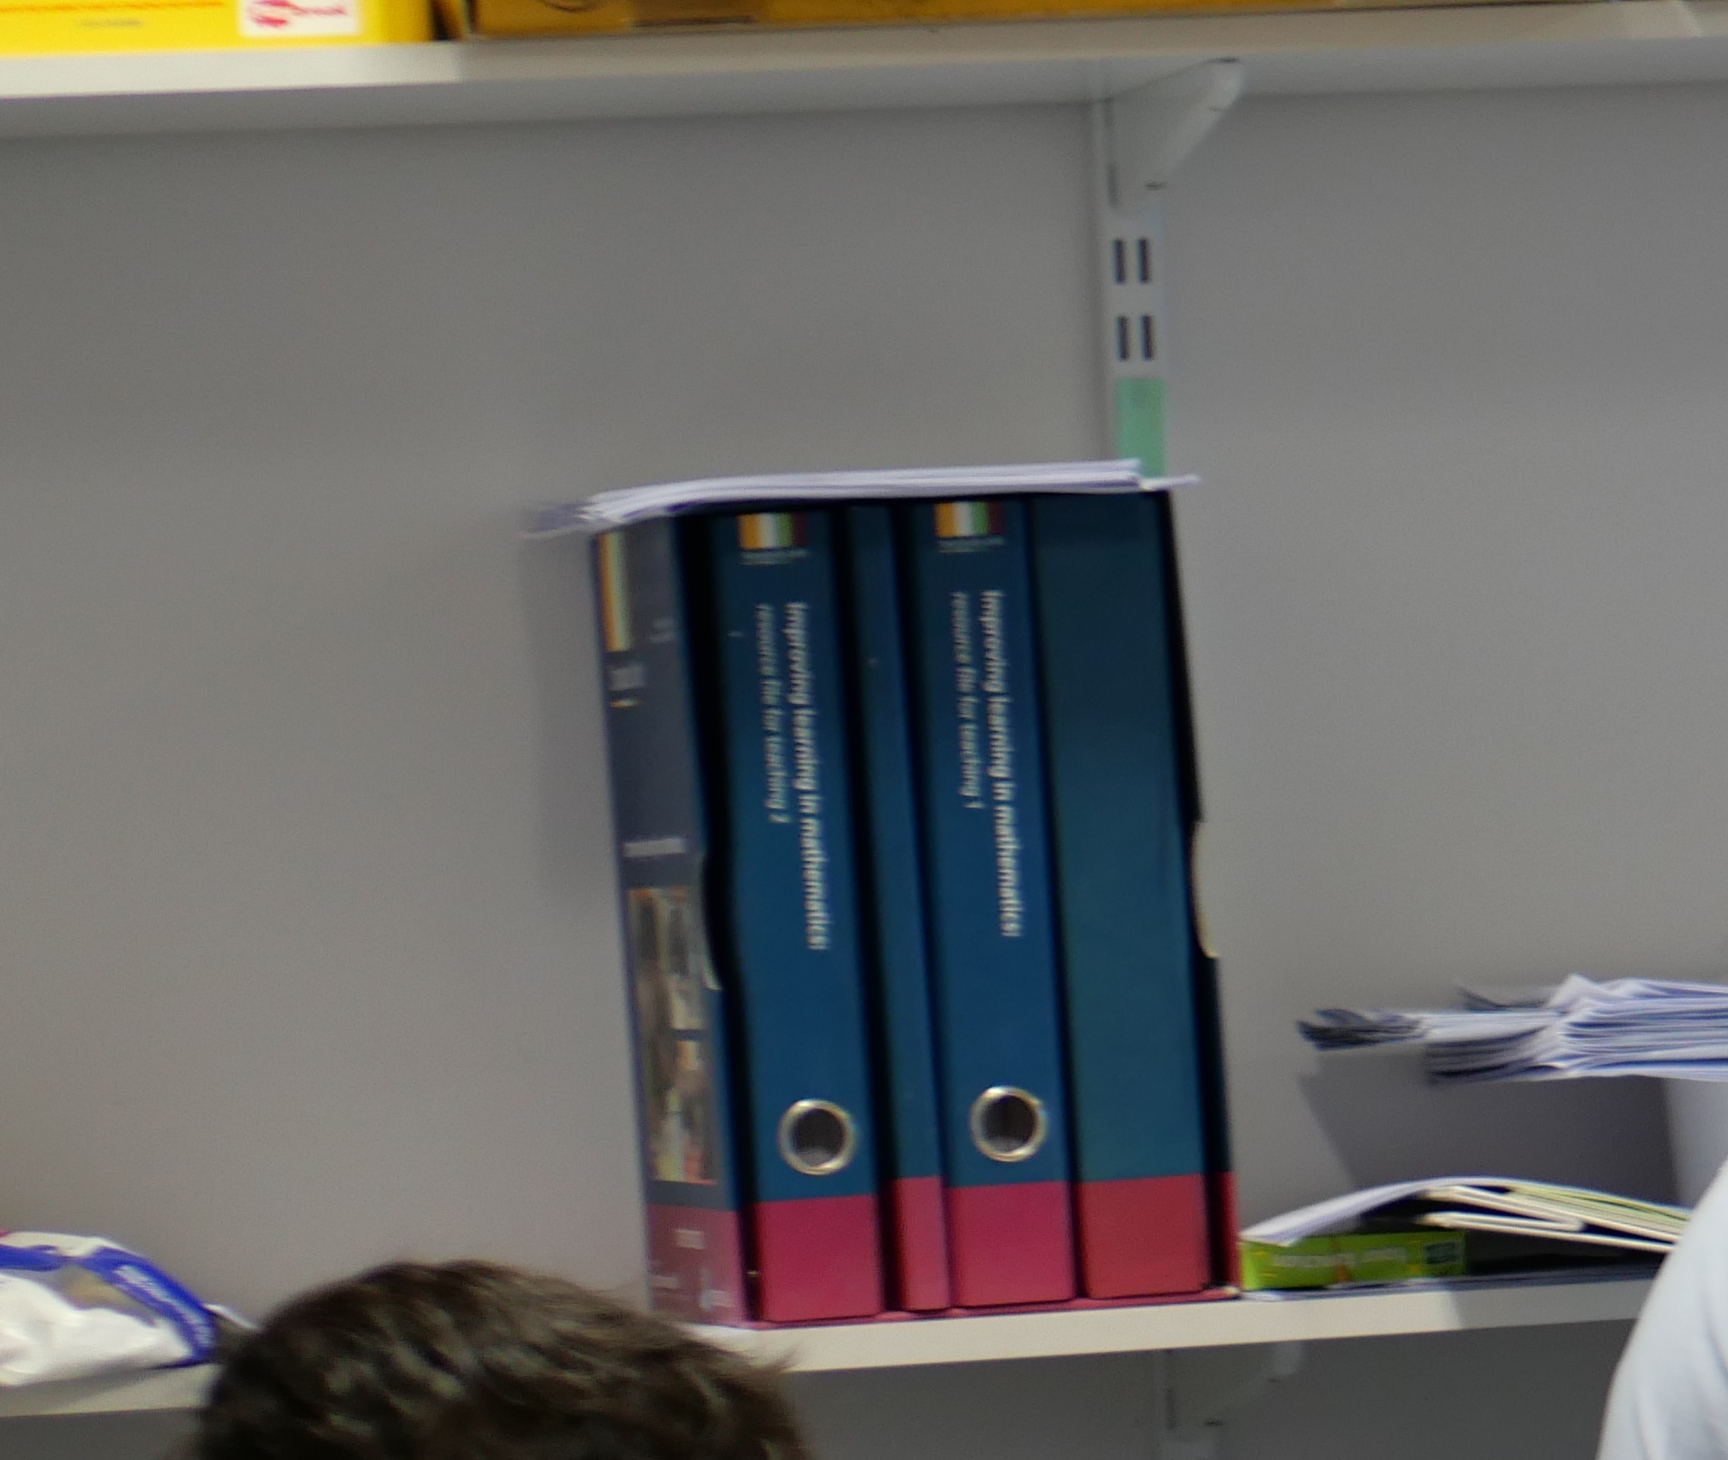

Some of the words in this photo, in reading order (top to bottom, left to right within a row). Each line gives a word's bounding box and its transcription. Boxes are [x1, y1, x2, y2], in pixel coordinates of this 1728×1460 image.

[755, 603, 777, 677] resource
[782, 601, 813, 705] Improving
[951, 591, 973, 665] resource
[980, 589, 1009, 693] Improving
[760, 679, 783, 705] file
[955, 667, 978, 693] file
[957, 696, 981, 719] for
[761, 708, 786, 732] for
[791, 709, 820, 791] learning
[986, 696, 1014, 778] learning
[763, 734, 789, 810] teaching
[958, 722, 982, 797] teaching
[992, 781, 1016, 802] in
[798, 794, 822, 815] in
[800, 817, 832, 950] mathematics
[993, 804, 1023, 937] mathematics
